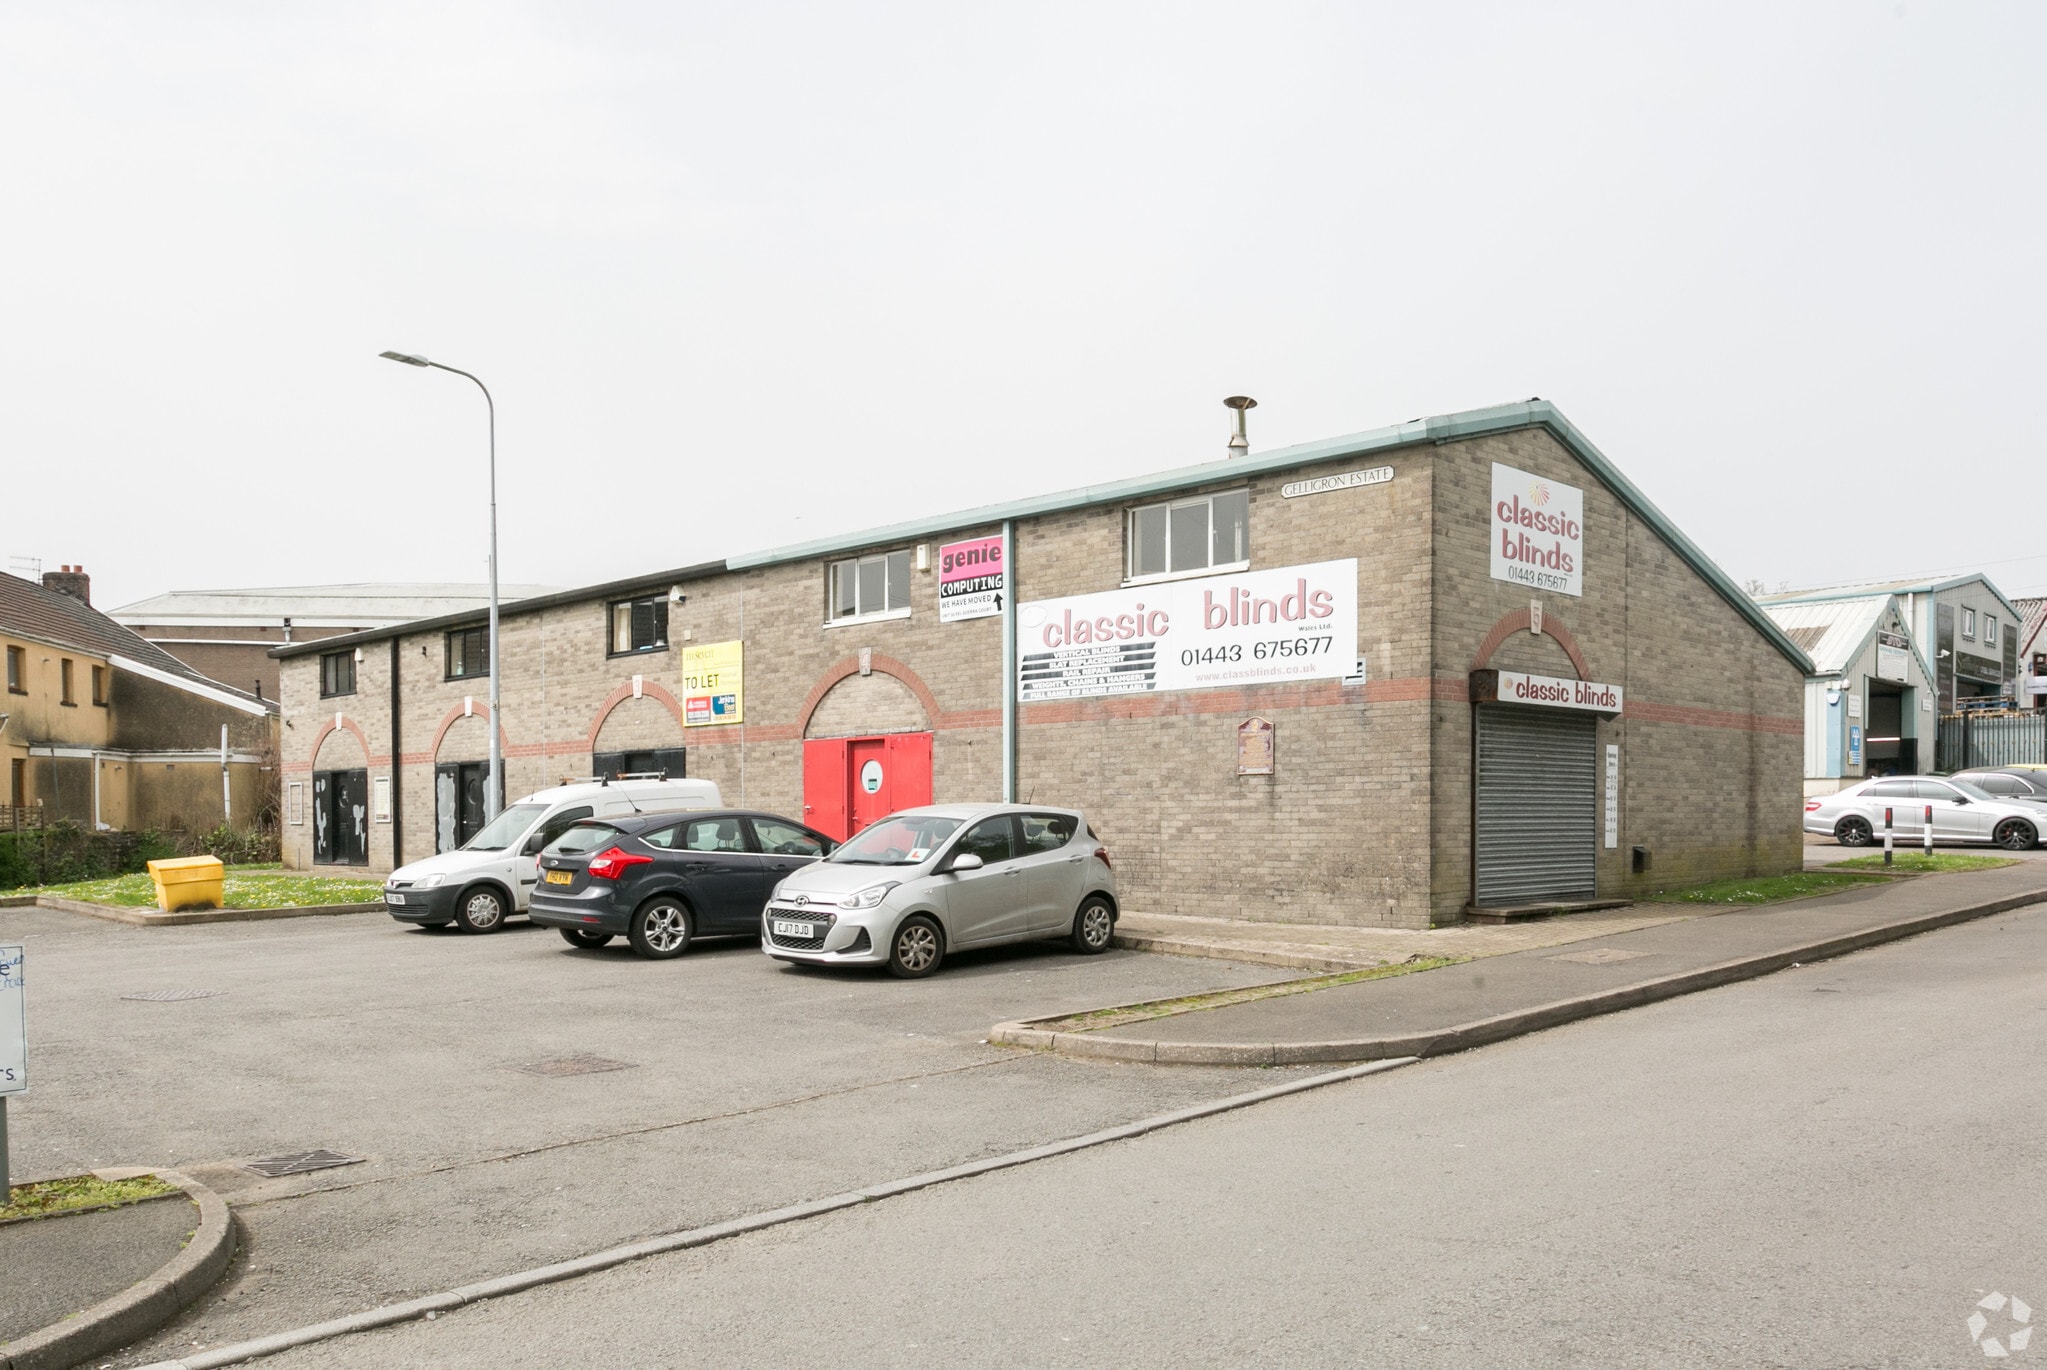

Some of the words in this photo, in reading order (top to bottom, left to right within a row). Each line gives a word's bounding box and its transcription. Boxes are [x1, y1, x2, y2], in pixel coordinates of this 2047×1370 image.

[1284, 476, 1346, 496] GELLIGRON
[1350, 467, 1391, 485] ESTATE
[1496, 494, 1579, 541] classic
[942, 543, 1002, 574] genie
[1502, 528, 1574, 573] blinds
[941, 574, 1003, 597] COMPUTING
[1508, 565, 1535, 584] 01443
[1537, 572, 1568, 591] 675677
[941, 600, 950, 609] WE
[951, 598, 967, 607] HAVE
[968, 594, 992, 604] MOVED
[1042, 603, 1169, 648] classic
[1203, 578, 1334, 630] blinds
[1048, 660, 1068, 669] SLAT
[1068, 655, 1126, 667] REPLACEMENT
[1053, 648, 1091, 659] VERTICAL
[1092, 645, 1121, 655] BLINDS
[1181, 644, 1242, 667] 01443
[1253, 636, 1333, 661] 675677
[685, 676, 698, 690] TO
[701, 673, 719, 688] LET
[1062, 669, 1082, 678] RAIL
[1081, 666, 1111, 676] REPAIR
[1067, 677, 1097, 687] CHAINS
[1106, 673, 1146, 683] HANGERS
[1195, 663, 1317, 682] www.classblinds.co.uk
[1081, 686, 1108, 696] BLINDS
[1107, 682, 1148, 694] AVAILABLE
[1516, 675, 1570, 703] classic
[1575, 681, 1617, 708] blinds
